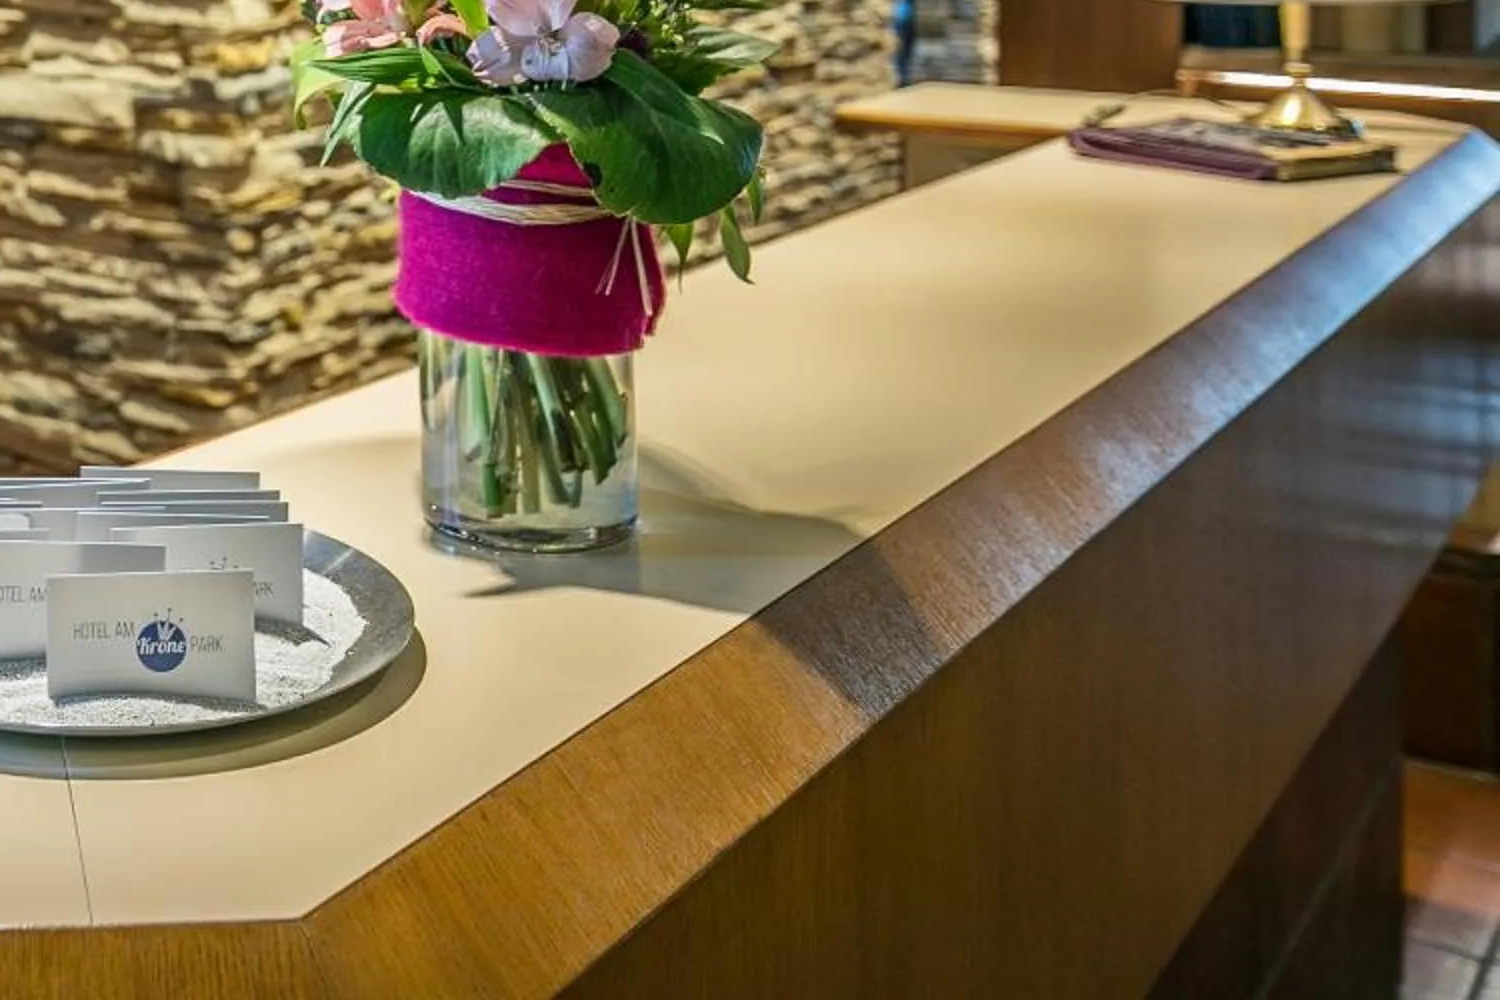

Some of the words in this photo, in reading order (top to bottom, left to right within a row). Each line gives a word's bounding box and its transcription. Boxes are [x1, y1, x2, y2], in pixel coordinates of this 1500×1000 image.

[253, 581, 276, 600] ARK
[73, 620, 111, 641] HOTEL
[115, 620, 135, 639] AM
[136, 636, 187, 656] Krone
[190, 635, 224, 654] PARK
